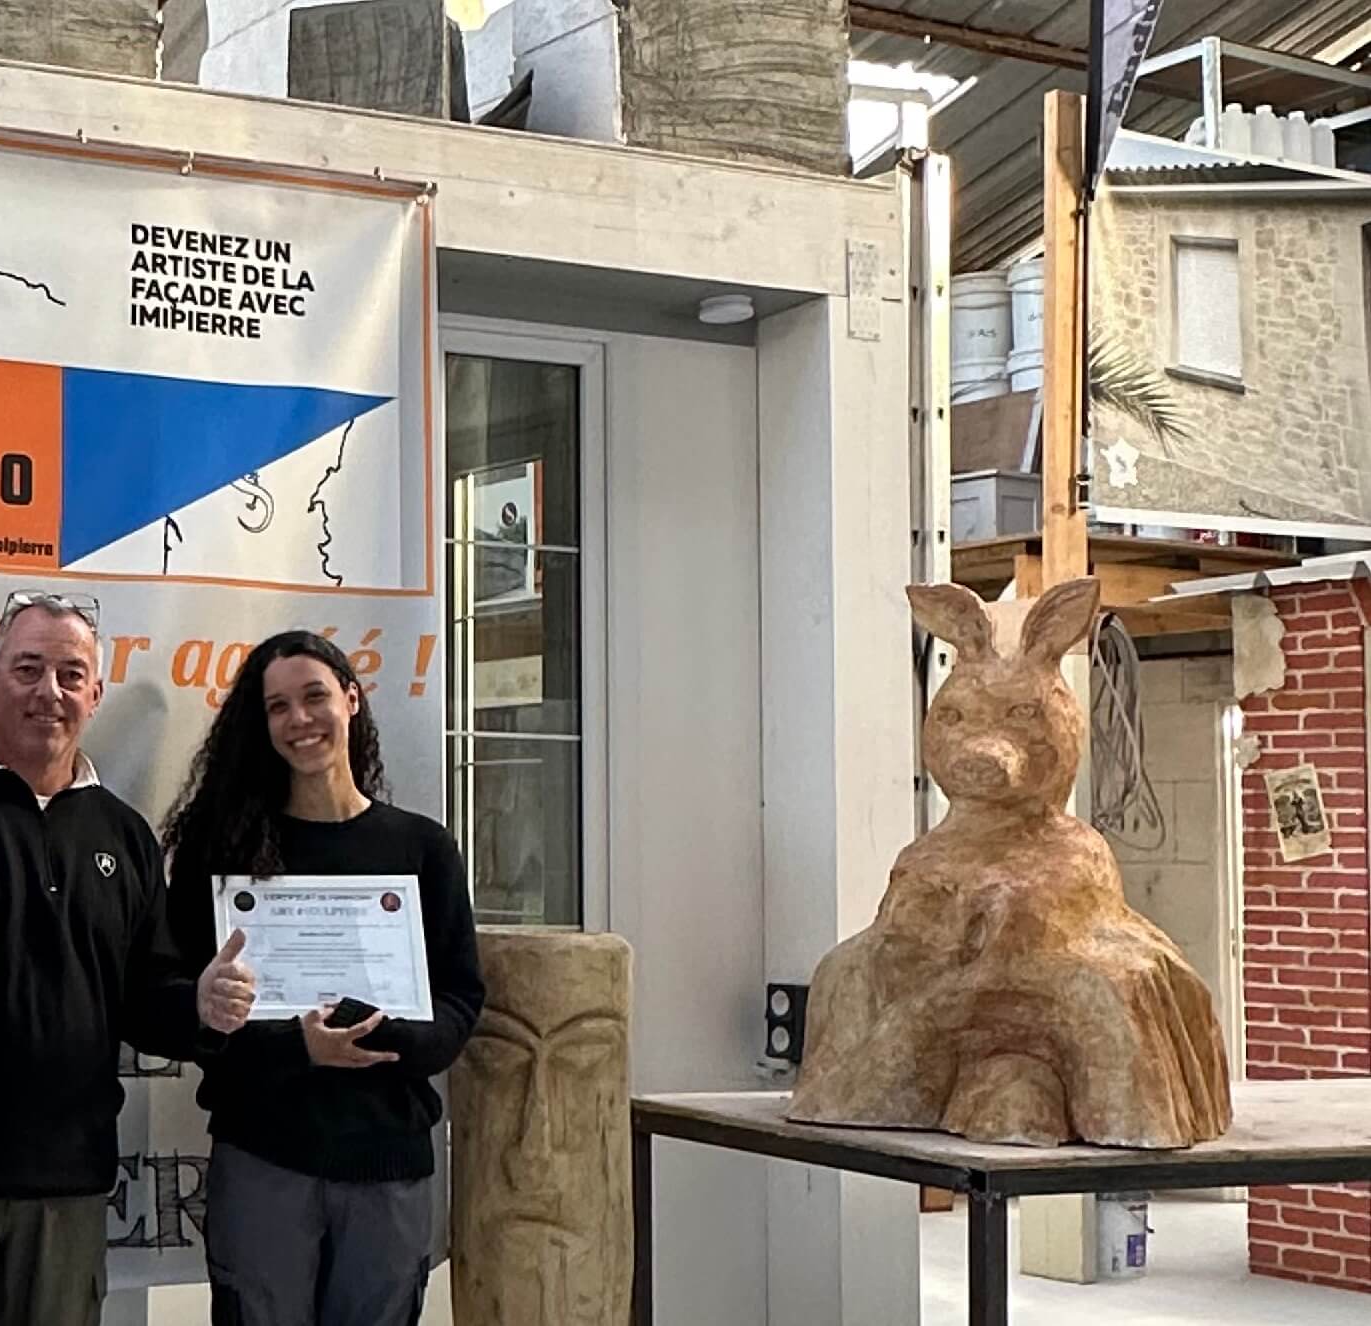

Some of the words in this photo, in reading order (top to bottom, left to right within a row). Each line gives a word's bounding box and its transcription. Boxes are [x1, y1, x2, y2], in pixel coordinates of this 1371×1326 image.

[131, 223, 249, 259] DEVENEZ
[254, 238, 291, 264] UN
[130, 250, 237, 284] ARTISTE
[243, 264, 276, 288] DE
[281, 268, 316, 292] LA
[131, 276, 233, 310] FAÇADE
[238, 290, 306, 317] AVEC
[130, 303, 261, 339] IMIPIERRE
